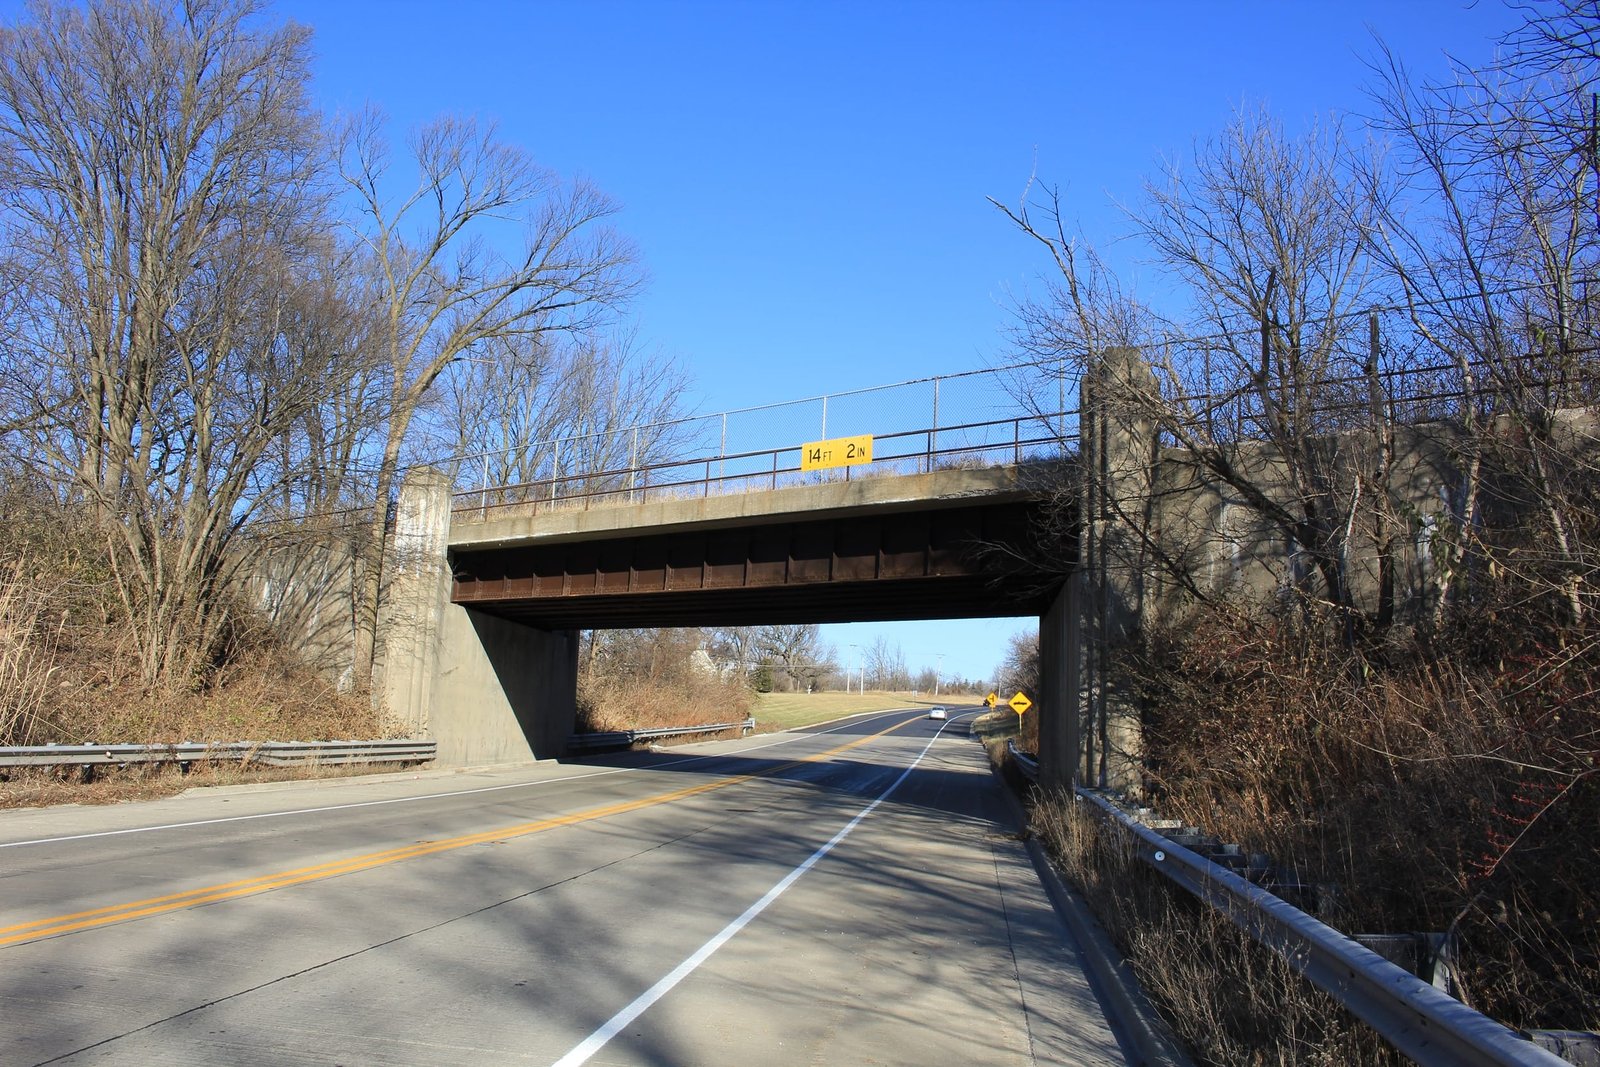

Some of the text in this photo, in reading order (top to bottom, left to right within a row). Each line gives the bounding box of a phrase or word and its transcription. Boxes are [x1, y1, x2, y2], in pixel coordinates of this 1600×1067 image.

[809, 443, 865, 463] 14 FT 2 IN
